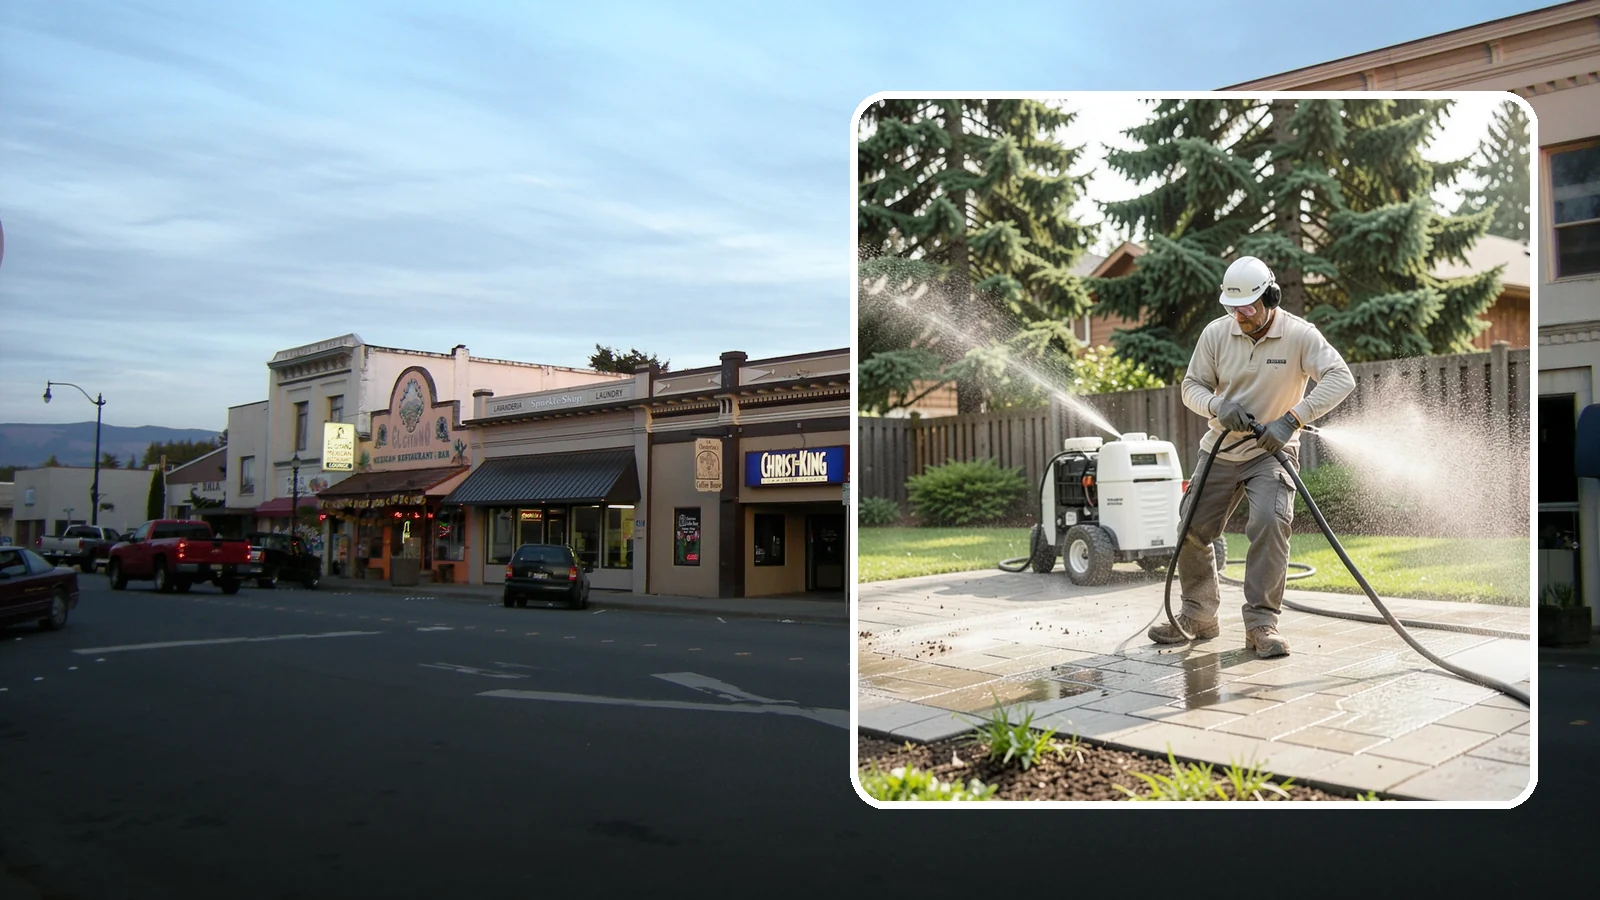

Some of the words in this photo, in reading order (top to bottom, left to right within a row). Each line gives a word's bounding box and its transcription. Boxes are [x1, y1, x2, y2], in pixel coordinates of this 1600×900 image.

[493, 402, 522, 412] LAVANDERIA
[531, 395, 561, 409] Sparkle
[562, 394, 582, 405] Shop
[595, 389, 623, 400] LAUNDRY
[373, 454, 396, 464] MEXICAN
[397, 452, 433, 462] RESTAURANT
[438, 450, 450, 459] BAR
[799, 450, 827, 476] KING
